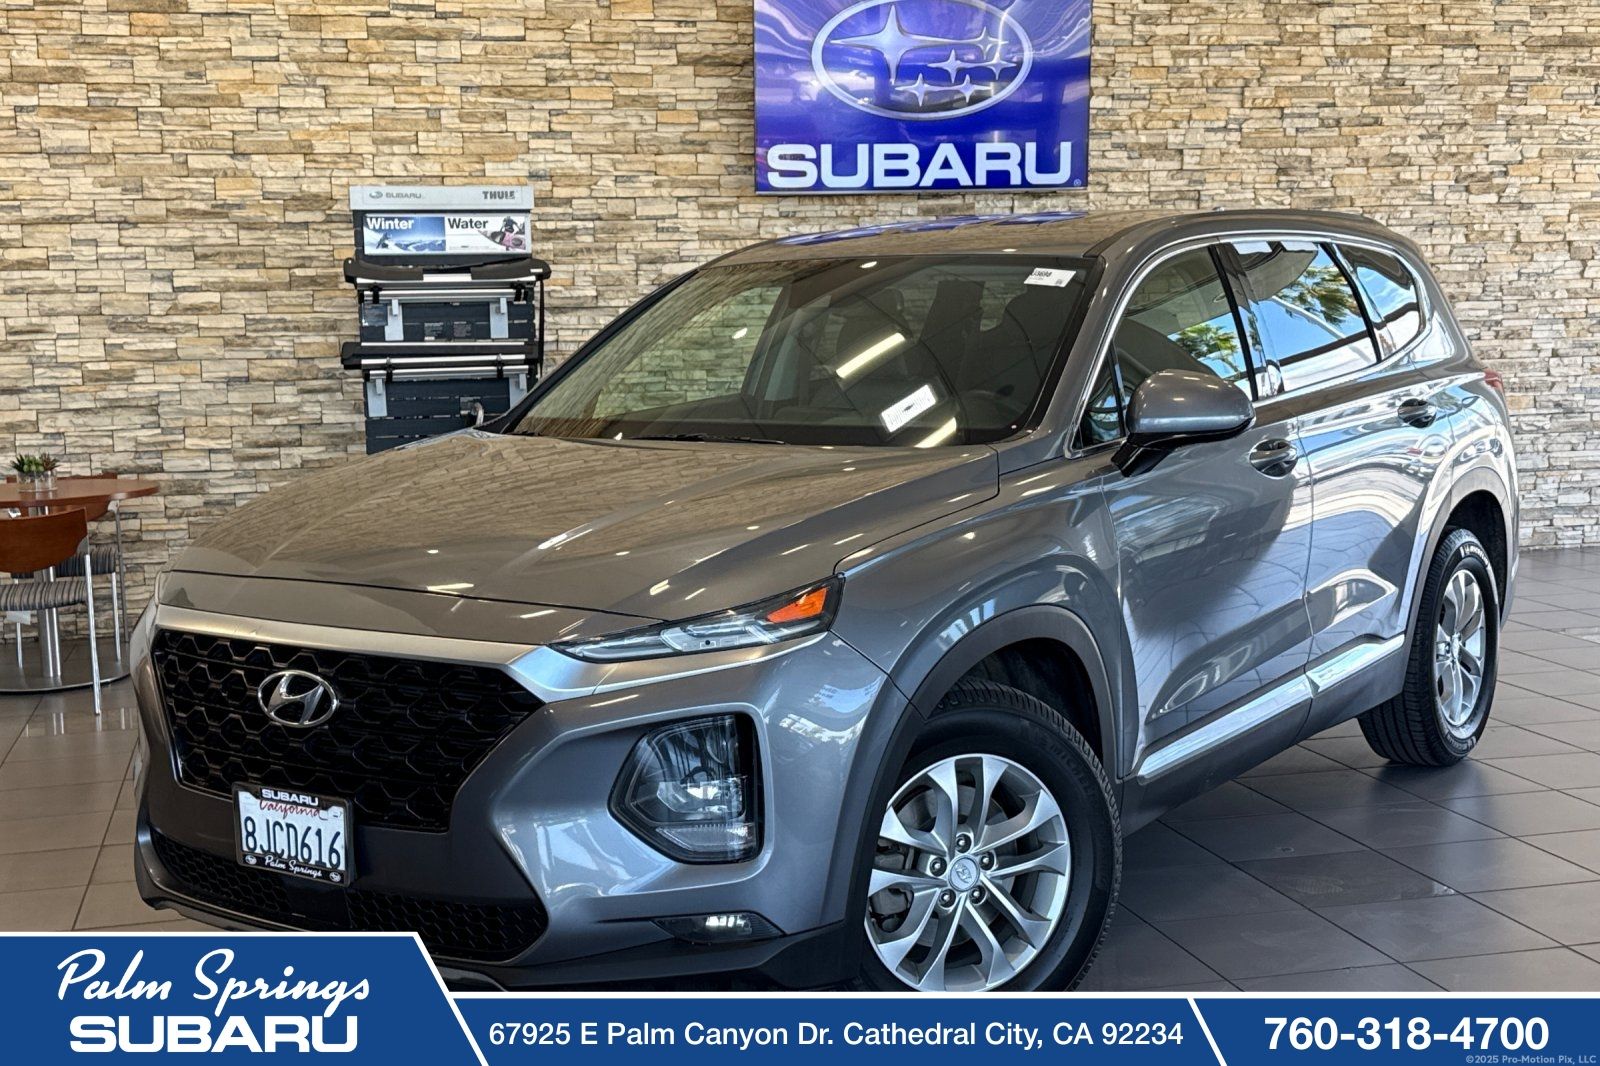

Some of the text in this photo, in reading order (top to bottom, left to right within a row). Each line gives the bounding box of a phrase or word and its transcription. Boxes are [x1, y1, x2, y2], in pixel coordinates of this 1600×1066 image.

[767, 141, 1072, 188] SUBARU
[482, 190, 516, 200] THULE
[366, 216, 414, 230] Winter
[447, 217, 489, 230] Water
[261, 788, 319, 806] SUBARU
[244, 815, 341, 870] 8JCD616
[264, 854, 323, 879] Palm Springs
